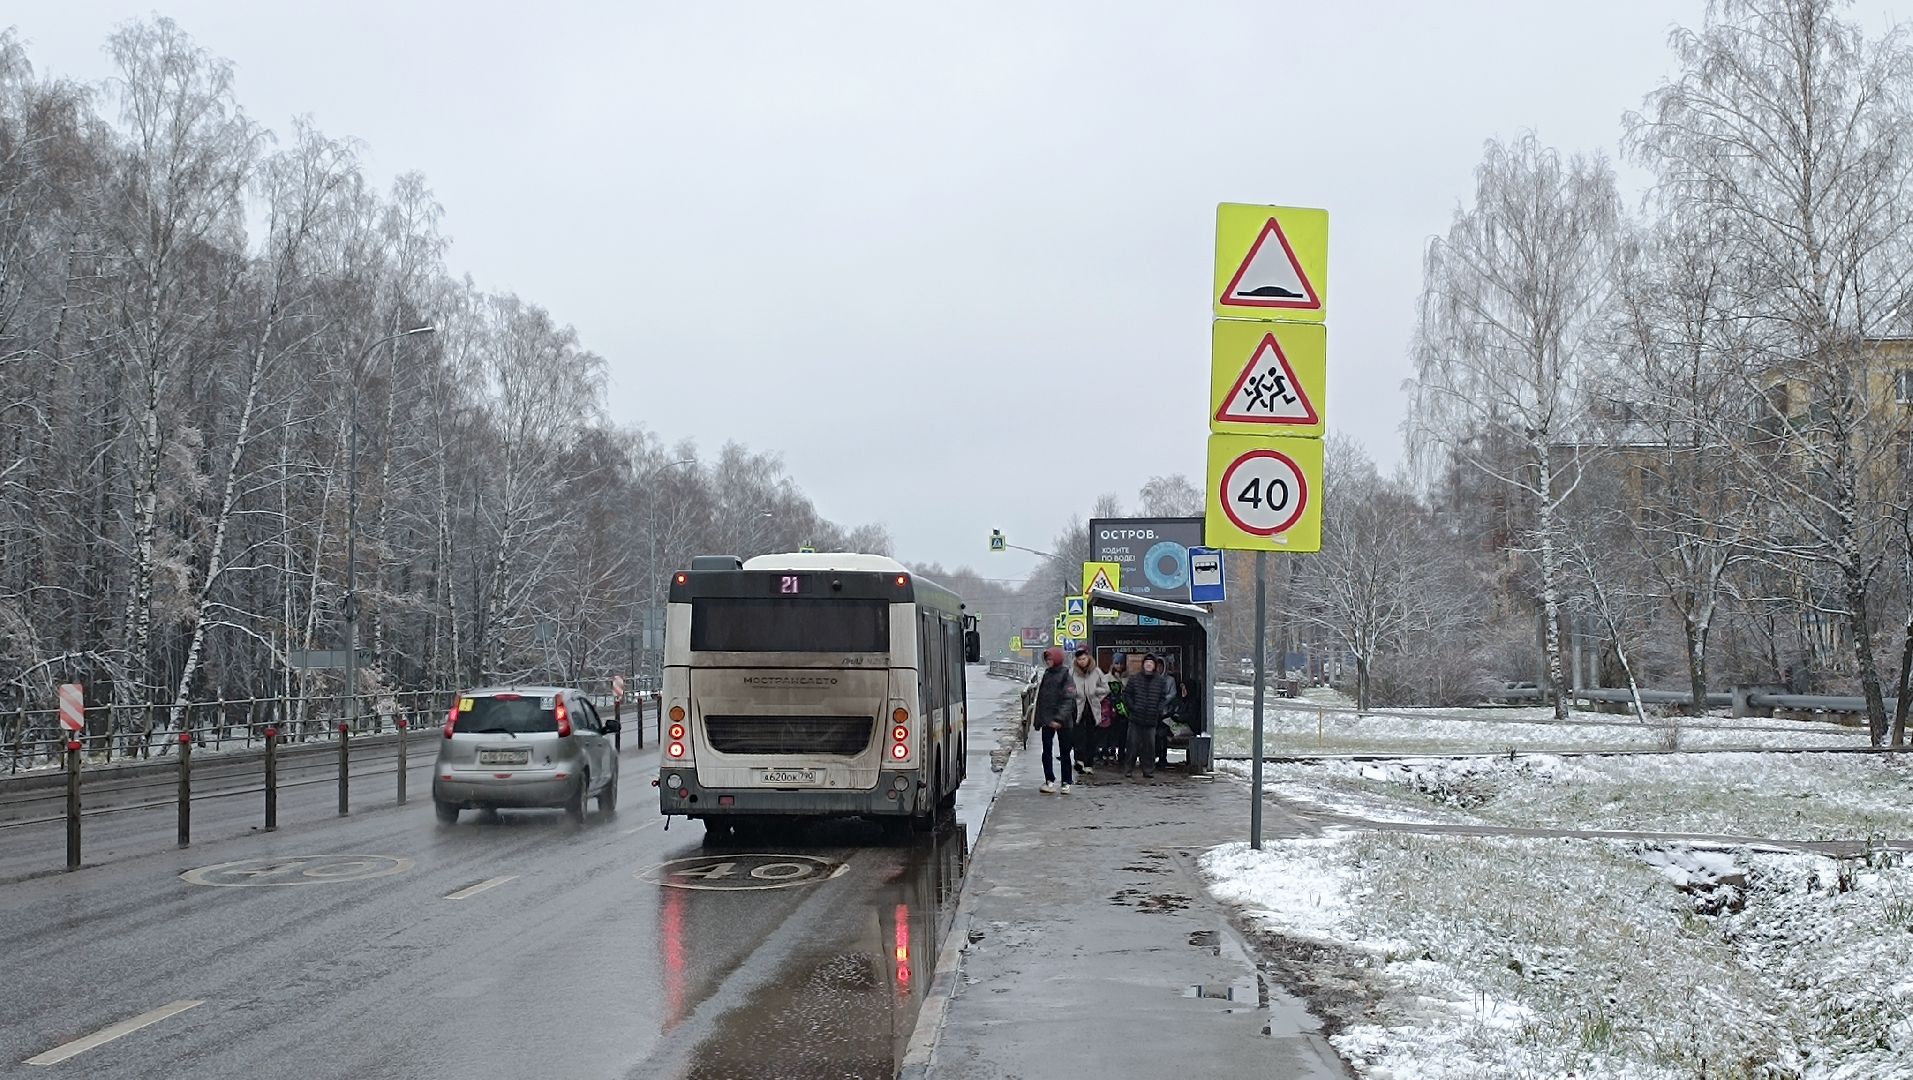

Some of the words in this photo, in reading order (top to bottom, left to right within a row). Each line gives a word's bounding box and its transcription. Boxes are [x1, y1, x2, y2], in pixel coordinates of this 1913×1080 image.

[1237, 477, 1289, 511] 40
[1100, 530, 1159, 540] ОСТРОВ.
[1101, 547, 1130, 555] ХОДИТЕ
[782, 576, 799, 593] 21
[743, 677, 838, 685] МОСТРАНСАВТО
[670, 862, 812, 879] 40
